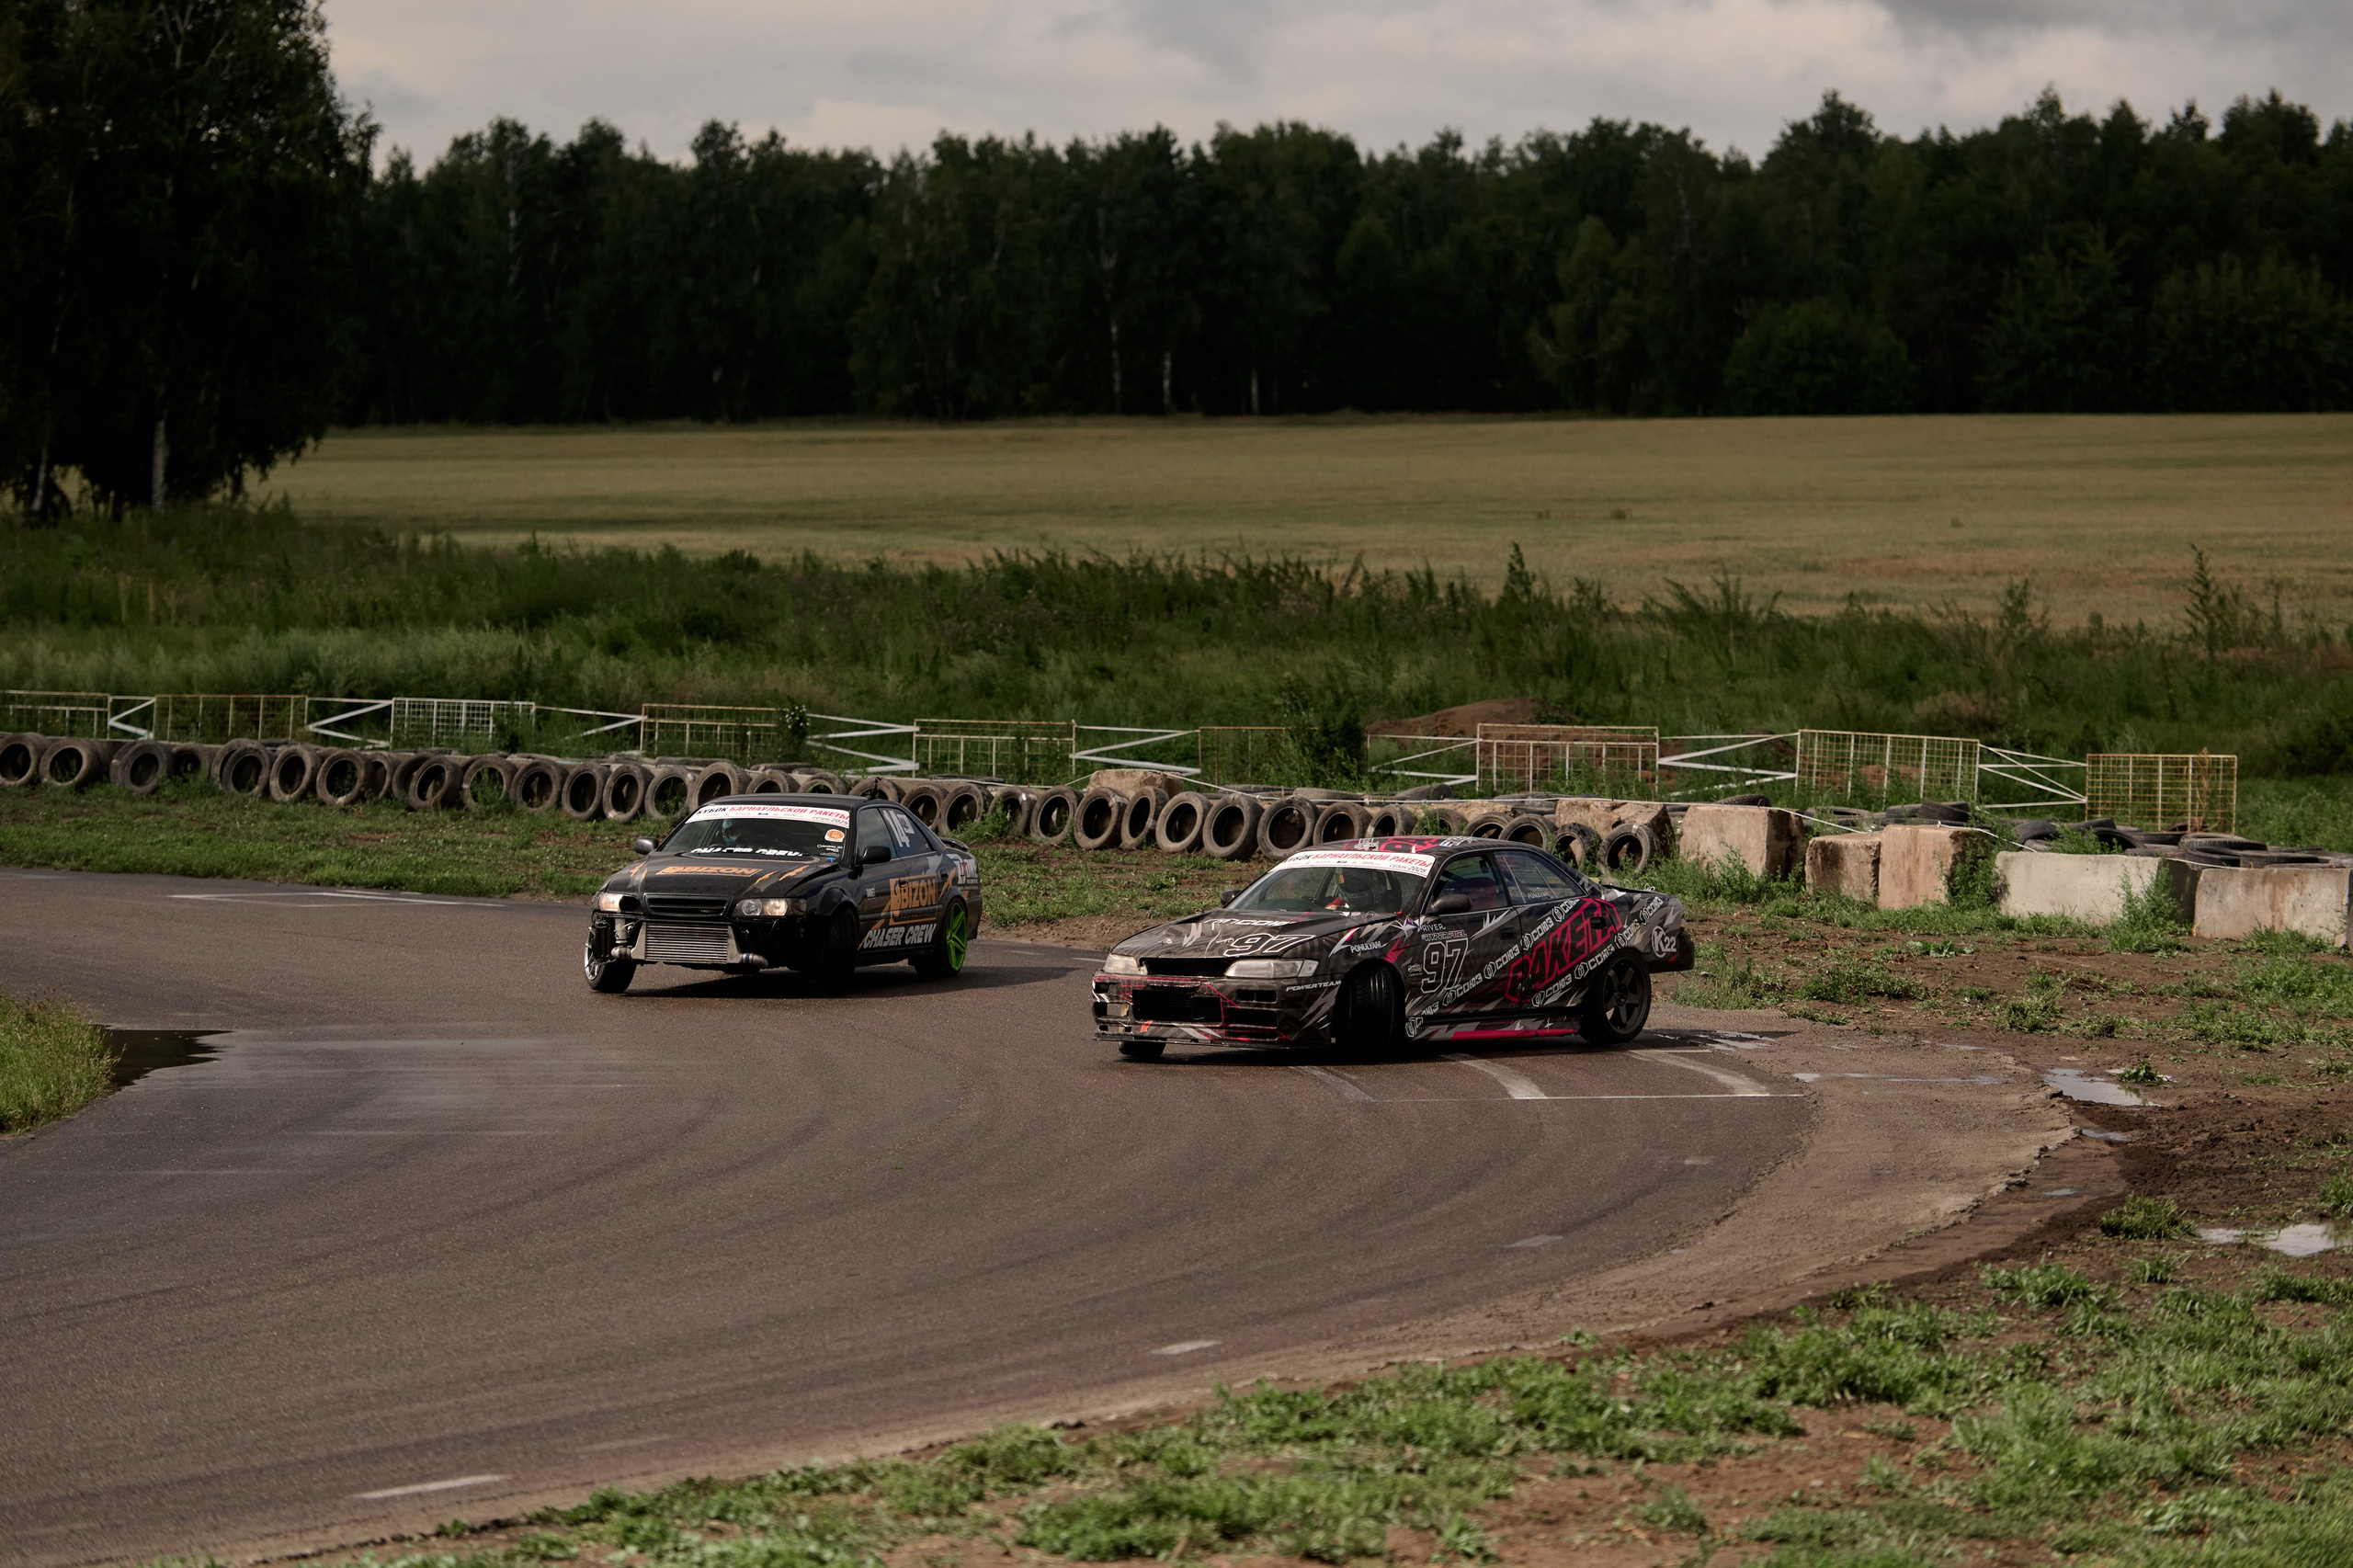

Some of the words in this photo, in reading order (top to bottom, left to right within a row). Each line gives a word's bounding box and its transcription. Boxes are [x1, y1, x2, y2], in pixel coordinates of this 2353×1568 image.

[697, 807, 726, 815] КУБОК
[729, 806, 808, 815] БАРНАУЛЬСКОЙ
[809, 809, 850, 821] РАКЕТЫ
[1312, 852, 1388, 861] БАРНАУЛЬСКОЙ
[1389, 856, 1433, 868] РАКЕТЫ
[901, 878, 937, 909] BIZON
[864, 926, 905, 949] CHASER
[905, 924, 937, 945] CREW
[1421, 923, 1447, 932] RIVER
[1222, 932, 1317, 957] 97
[1420, 937, 1469, 994] 97
